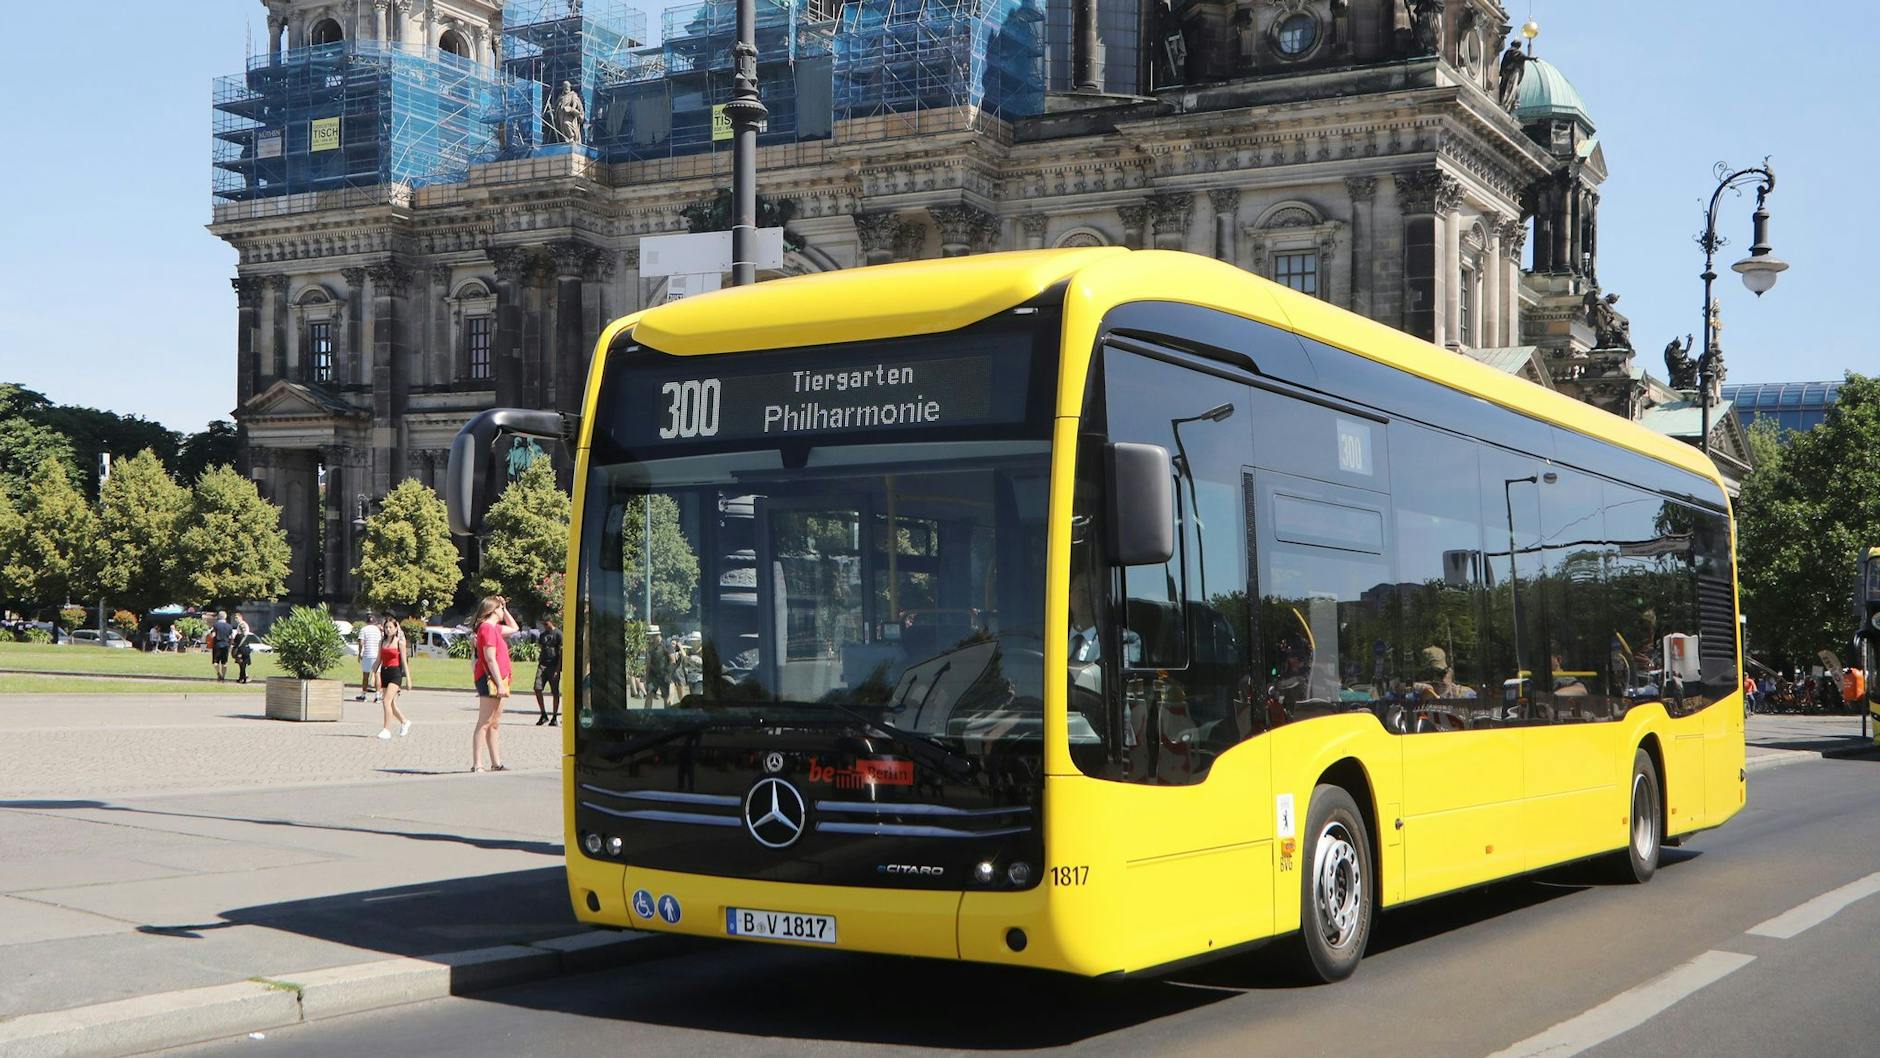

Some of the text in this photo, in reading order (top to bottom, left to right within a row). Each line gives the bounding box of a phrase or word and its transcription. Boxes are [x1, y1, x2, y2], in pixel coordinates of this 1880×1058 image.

[313, 127, 339, 139] TISCH
[714, 115, 732, 126] TIS
[792, 364, 914, 393] Tiergarten
[659, 377, 722, 440] 300
[763, 395, 940, 433] Philharmonie
[1341, 432, 1362, 469] 300
[808, 757, 835, 784] be
[1050, 866, 1089, 886] 1817
[744, 912, 828, 939] B V 1817
